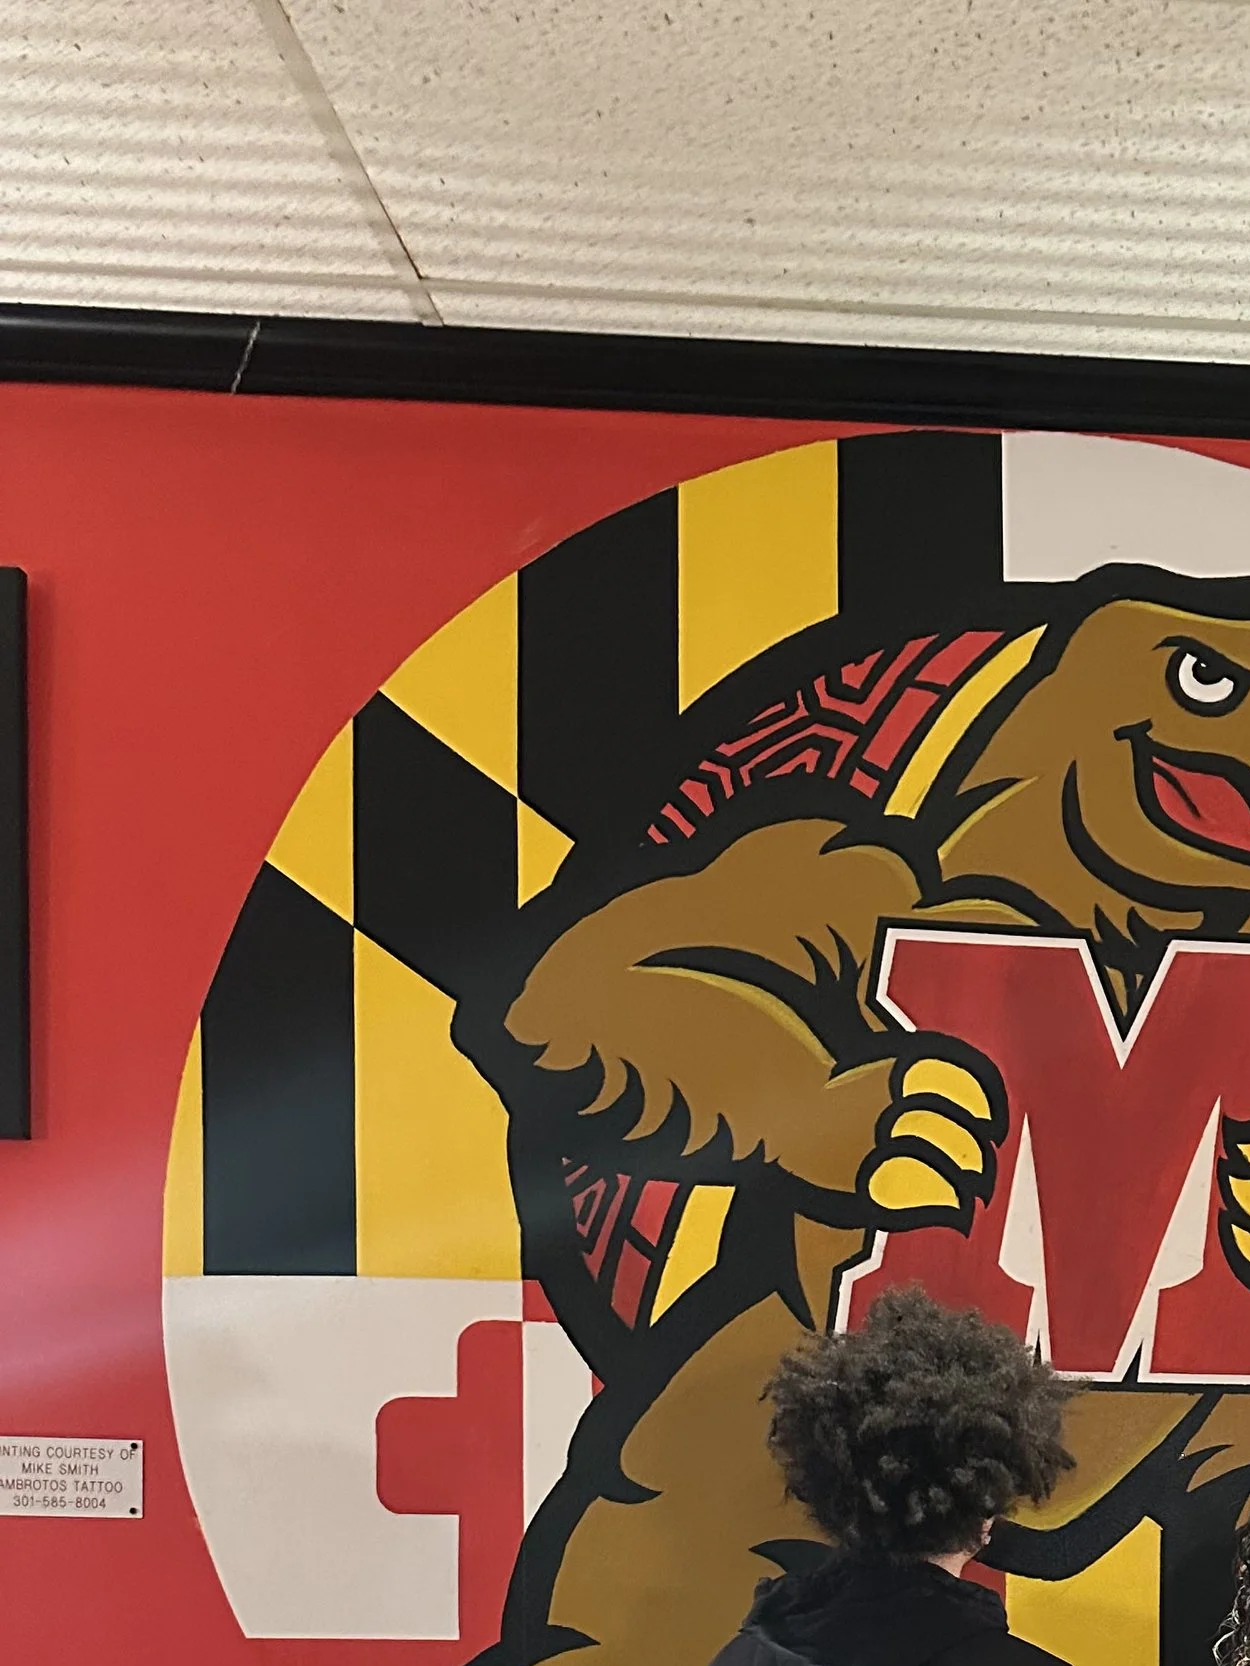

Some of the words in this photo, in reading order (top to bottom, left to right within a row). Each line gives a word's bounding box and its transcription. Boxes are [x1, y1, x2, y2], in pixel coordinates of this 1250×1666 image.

[47, 1446, 114, 1460] COURTESY
[120, 1448, 136, 1461] OF
[22, 1462, 52, 1475] MIKE
[59, 1463, 99, 1476] SMITH
[74, 1480, 123, 1494] TATTOO
[13, 1494, 106, 1509] 301-585-8004
